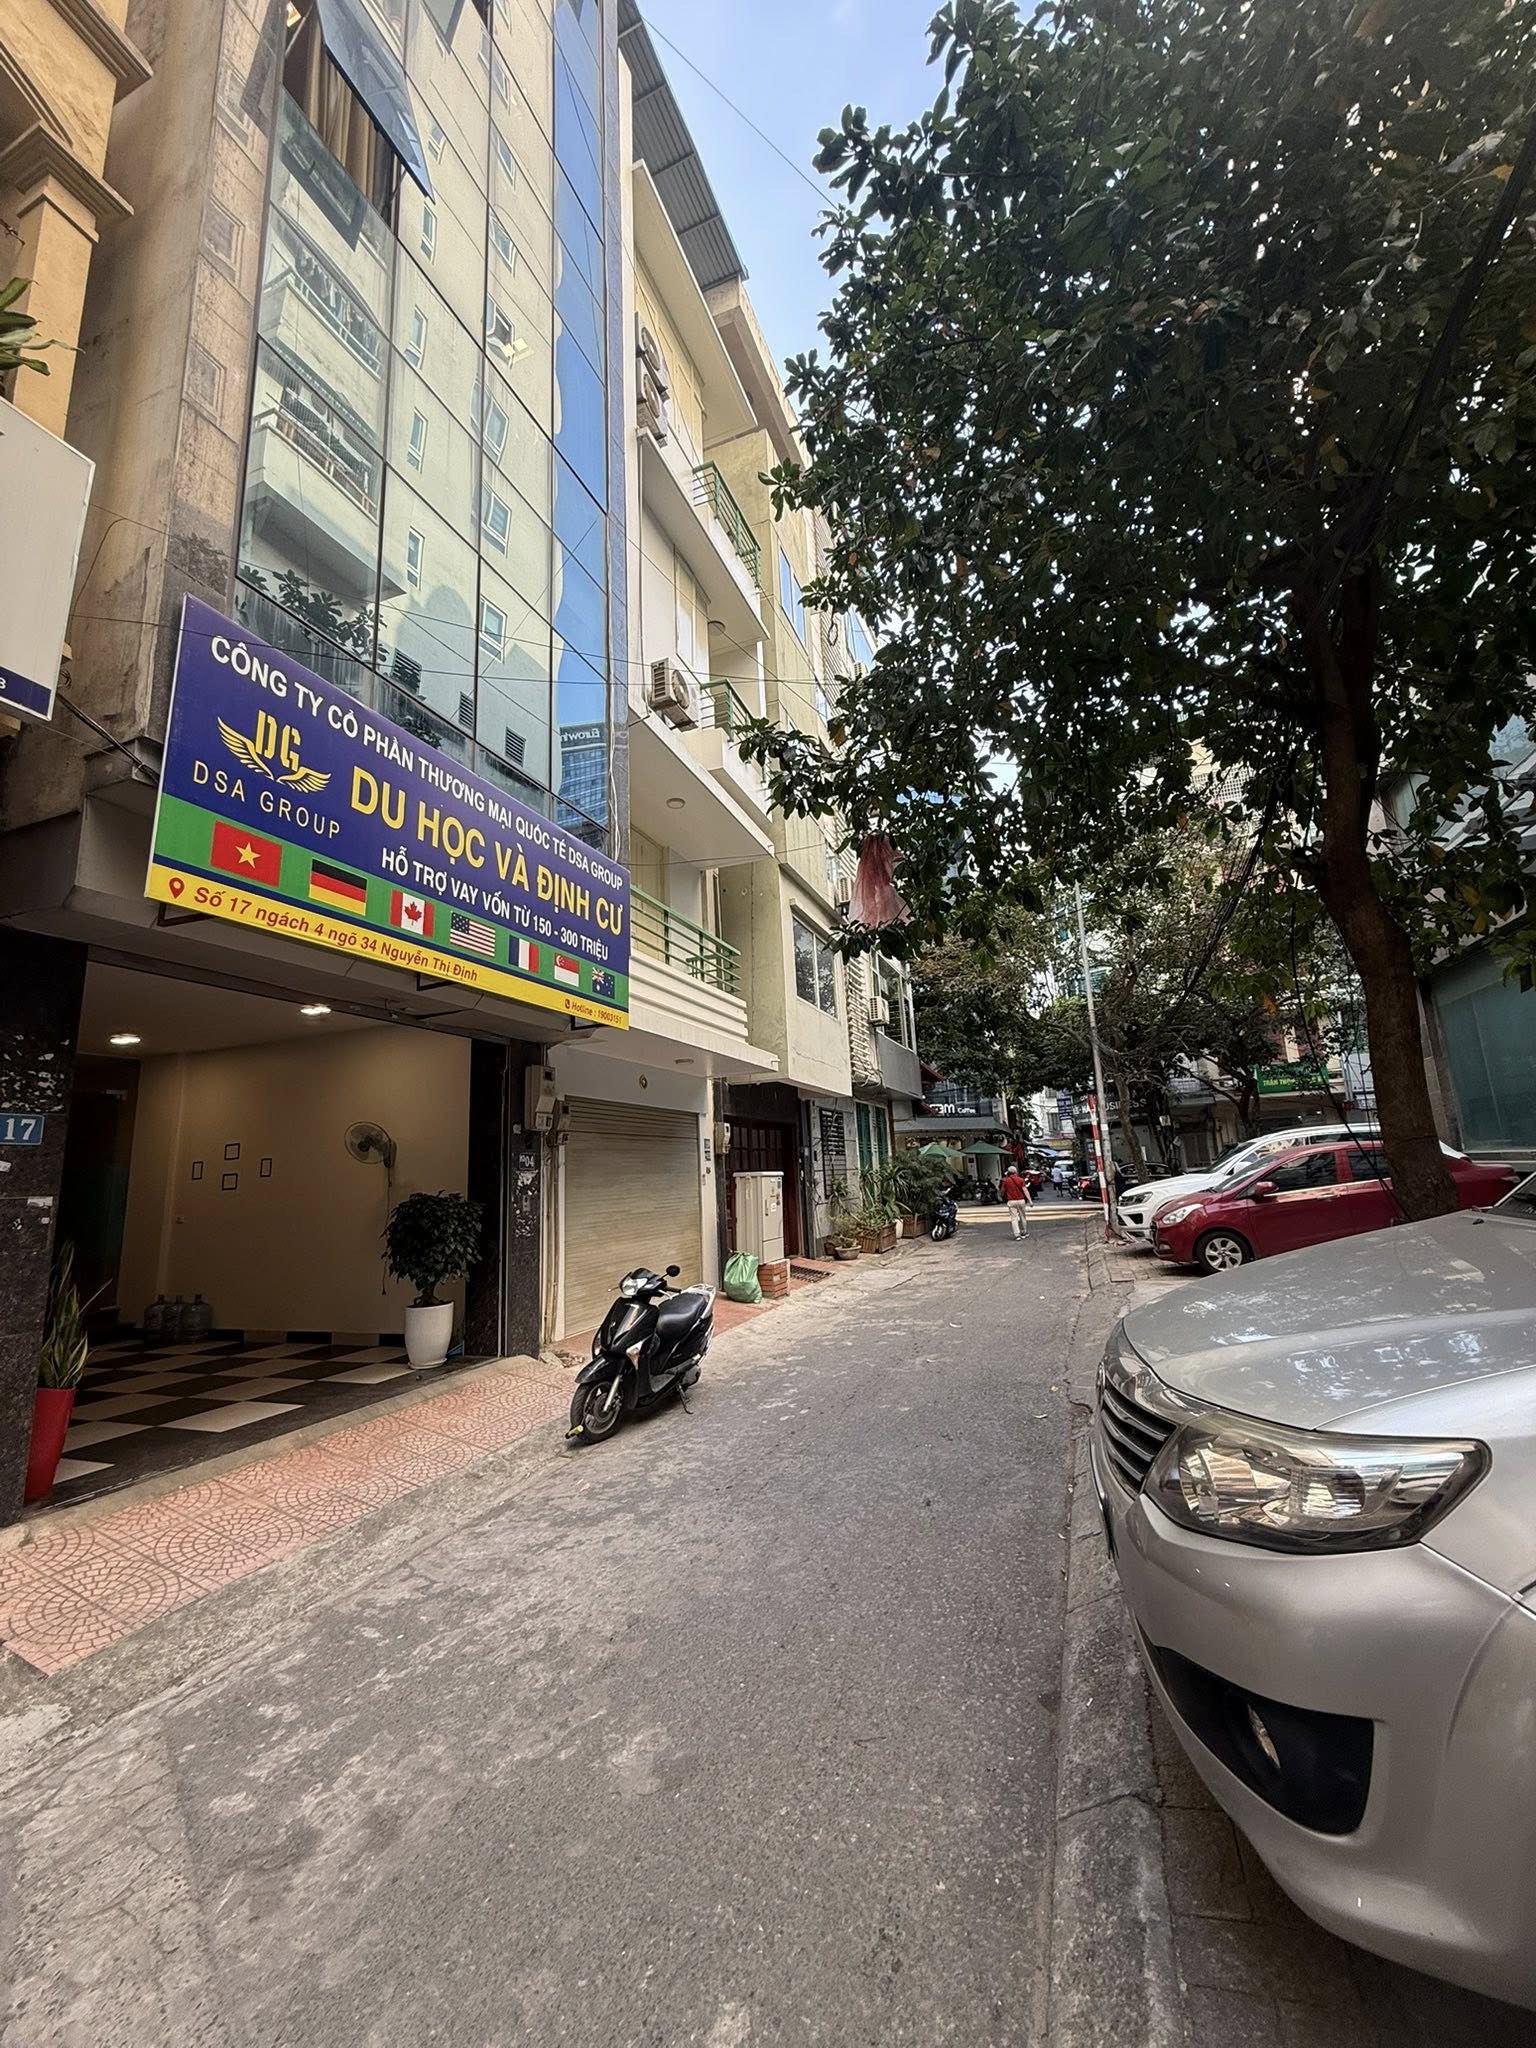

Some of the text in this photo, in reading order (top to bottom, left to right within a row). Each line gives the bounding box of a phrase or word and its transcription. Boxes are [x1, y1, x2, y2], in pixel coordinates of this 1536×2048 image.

[193, 759, 341, 839] DSA GROUP
[211, 635, 288, 698] CÔNG
[294, 681, 324, 718] TY
[418, 756, 485, 812] THƯƠNG
[488, 798, 512, 830] MẠI
[568, 846, 590, 873] DSA
[590, 861, 623, 890] GROUP
[351, 765, 624, 936] DU HỌC VÀ ĐỊNH CƯ
[194, 886, 227, 908] Số
[230, 897, 253, 915] 17
[255, 907, 309, 933] ngách
[314, 922, 324, 937] 4
[328, 928, 358, 947] ngõ
[360, 936, 377, 952] 34
[380, 942, 429, 968] Nguyễn
[381, 845, 409, 876] HỖ
[412, 860, 448, 896] TRỢ
[450, 877, 479, 906] VAY
[482, 890, 510, 920] VỐN
[513, 904, 531, 928] TỪ
[533, 914, 552, 937] 150
[560, 926, 578, 948] 300
[580, 934, 609, 961] TRIỆU
[3, 1117, 37, 1141] 17
